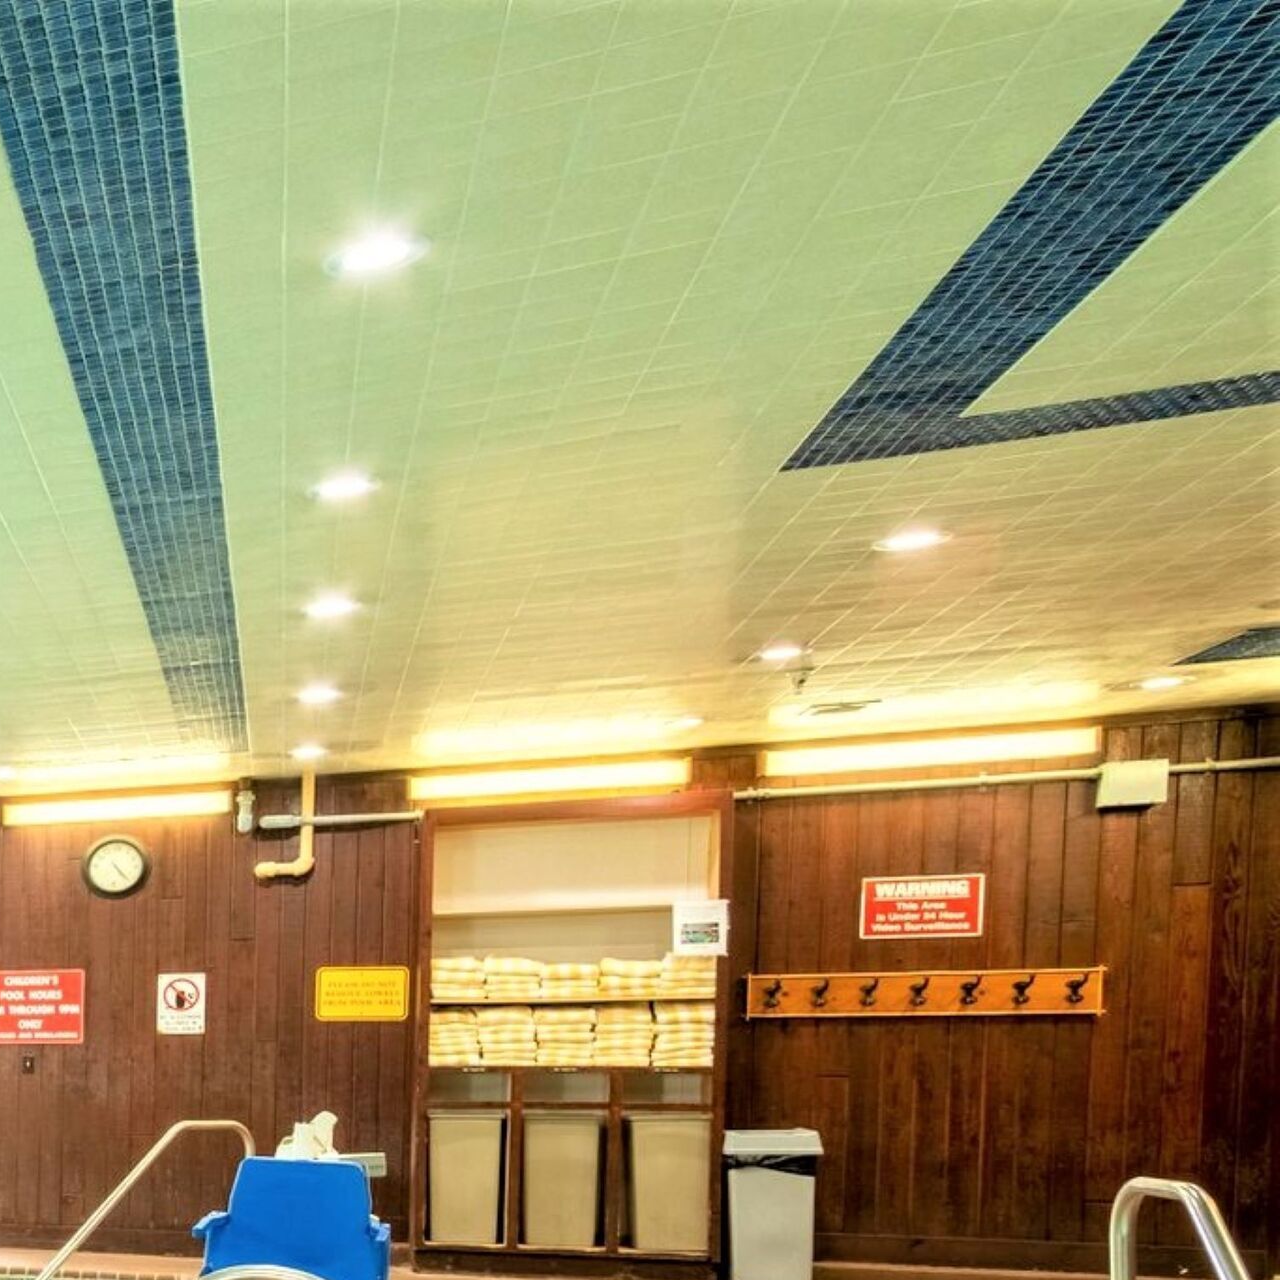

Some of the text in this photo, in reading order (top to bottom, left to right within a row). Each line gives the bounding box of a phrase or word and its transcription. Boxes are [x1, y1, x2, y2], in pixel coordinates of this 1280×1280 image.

[874, 880, 970, 898] WARNING
[896, 902, 947, 911] This Area
[887, 912, 920, 921] Under
[922, 911, 937, 920] 24
[938, 911, 967, 920] Hour
[871, 921, 971, 932] Video Surveillance
[3, 975, 59, 987] CHILDREN'S
[0, 989, 63, 1001] POOL HOURS
[8, 1004, 56, 1015] THROUGH
[17, 1019, 43, 1030] ONLY
